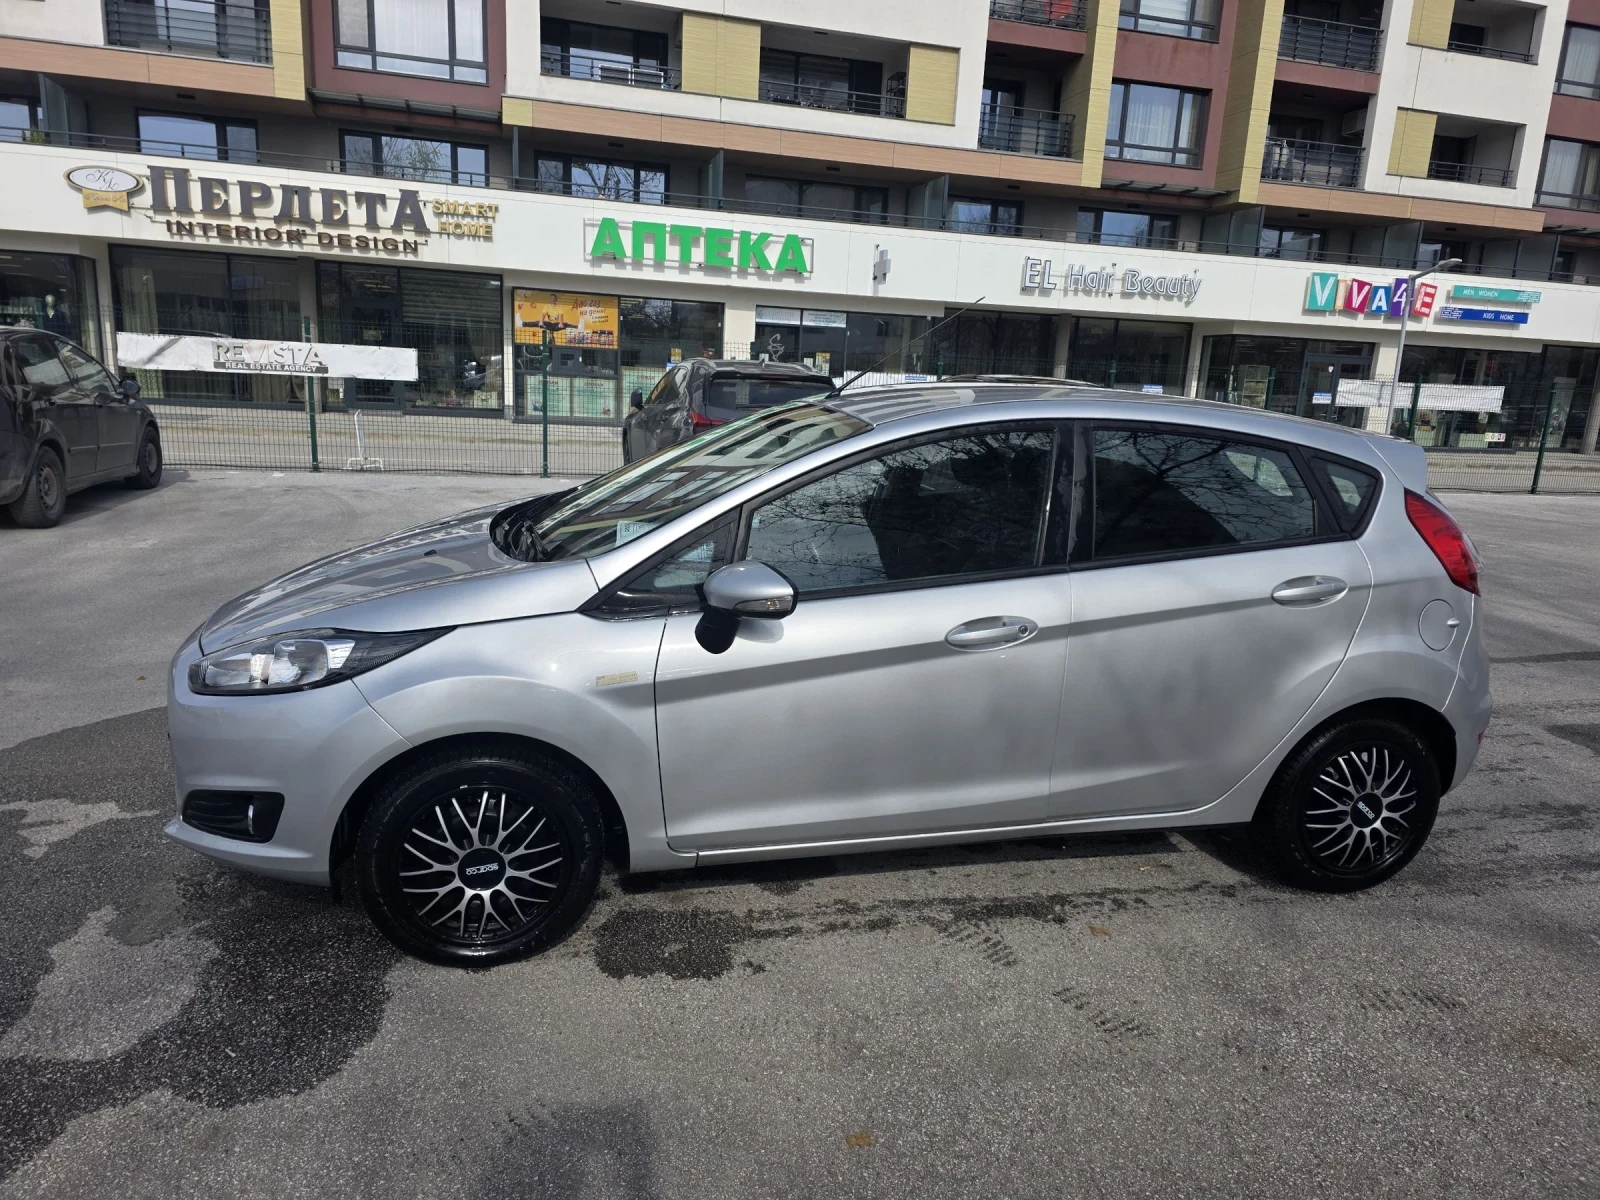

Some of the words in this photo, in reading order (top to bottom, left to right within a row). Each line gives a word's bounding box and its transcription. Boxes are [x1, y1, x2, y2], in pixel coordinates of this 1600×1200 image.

[147, 165, 430, 232] ПЕРДЕТА
[432, 198, 499, 217] SMART
[166, 219, 306, 244] INTERIOR
[318, 232, 418, 252] DESIGN
[438, 219, 493, 237] HOME
[590, 217, 808, 274] АПТЕКА
[1024, 257, 1057, 290] EL
[1068, 264, 1115, 291] Hair
[1125, 268, 1202, 301] Beauty
[1483, 312, 1495, 320] KIDS
[1499, 313, 1515, 321] HOME
[211, 341, 327, 366] REVISTA
[284, 365, 317, 373] AGENCY
